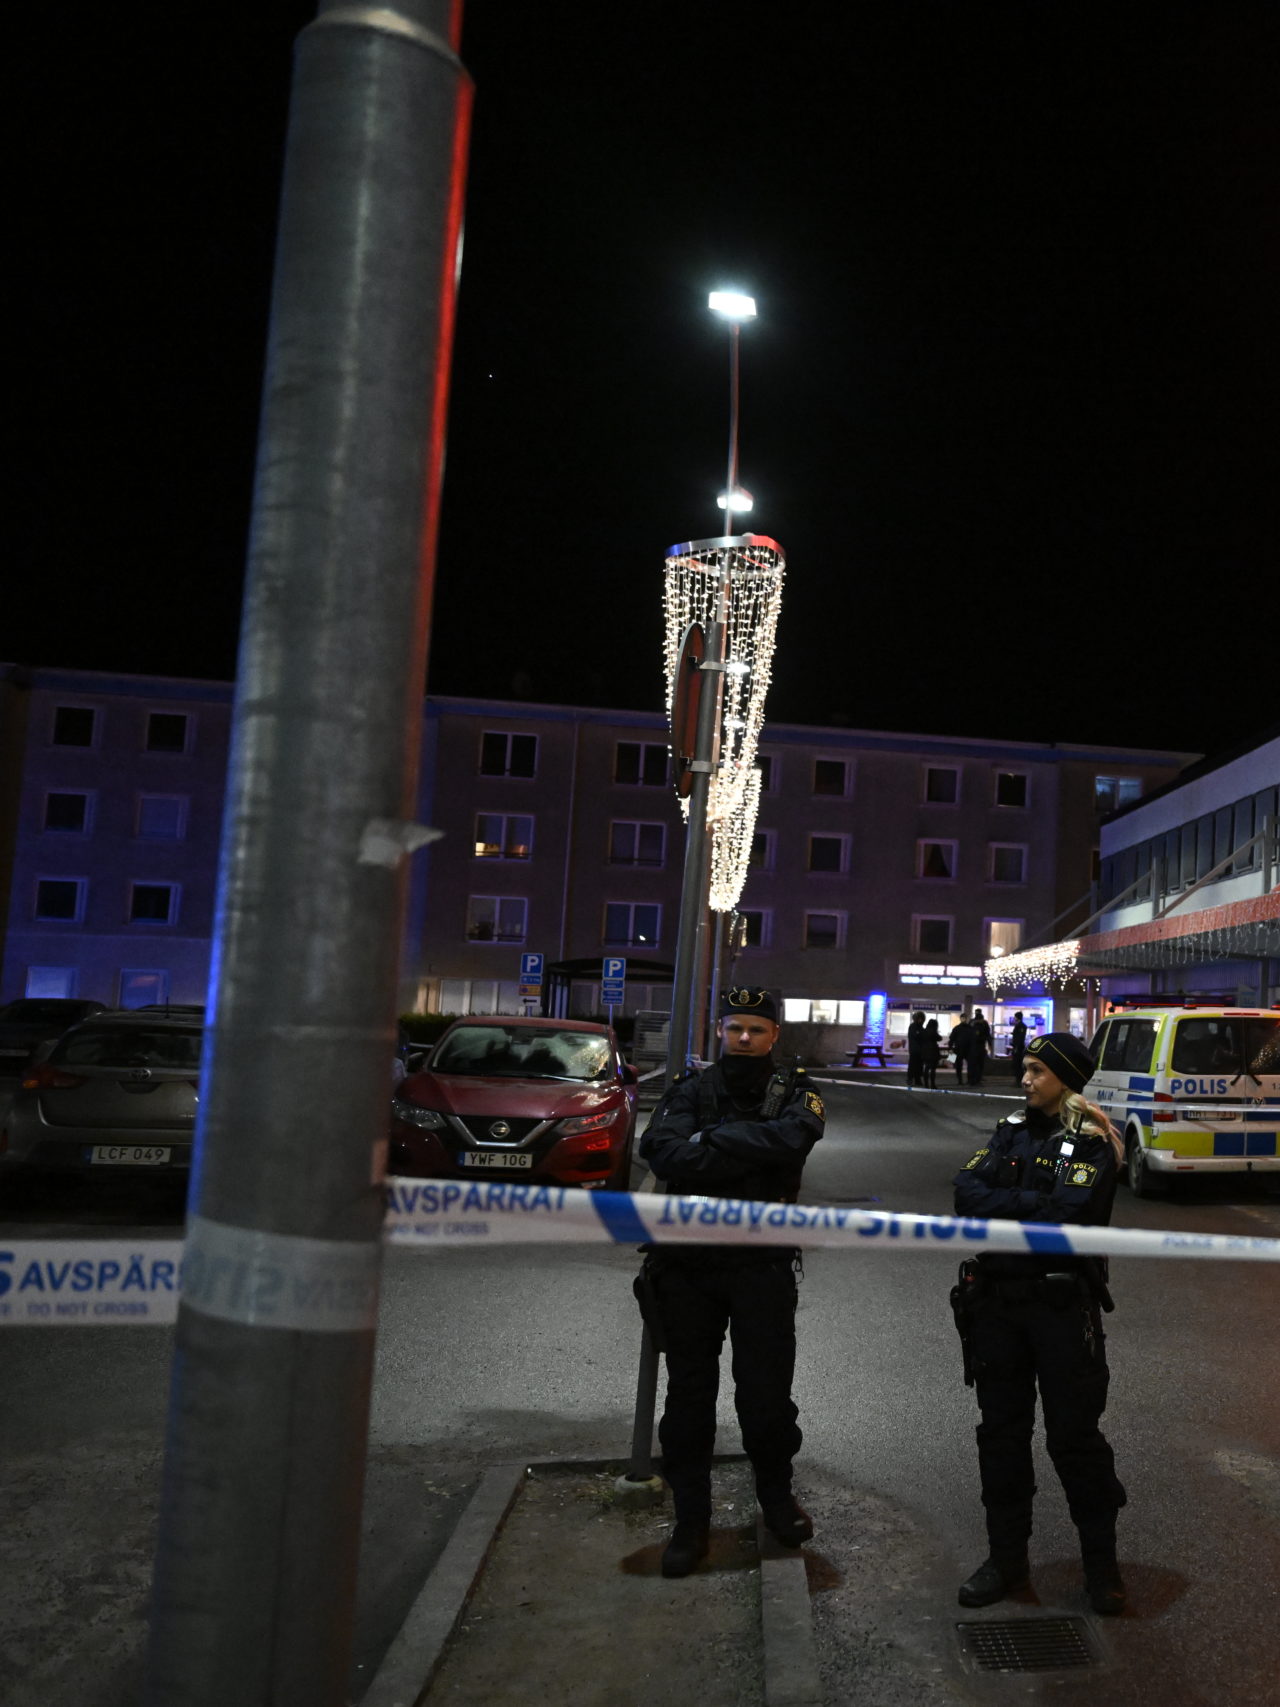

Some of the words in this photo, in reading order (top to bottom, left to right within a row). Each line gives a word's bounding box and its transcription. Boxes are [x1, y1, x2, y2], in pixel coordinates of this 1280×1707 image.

[526, 955, 539, 972] P
[608, 960, 622, 977] P
[1170, 1079, 1228, 1095] POLIS
[98, 1148, 128, 1160] LCF
[133, 1149, 164, 1160] 049
[470, 1153, 496, 1165] YWF
[502, 1155, 527, 1166] 10G
[1073, 1164, 1096, 1173] POLIS
[19, 1253, 183, 1292] AVSPÄR
[56, 1302, 88, 1316] NOT
[94, 1302, 148, 1316] CROSS
